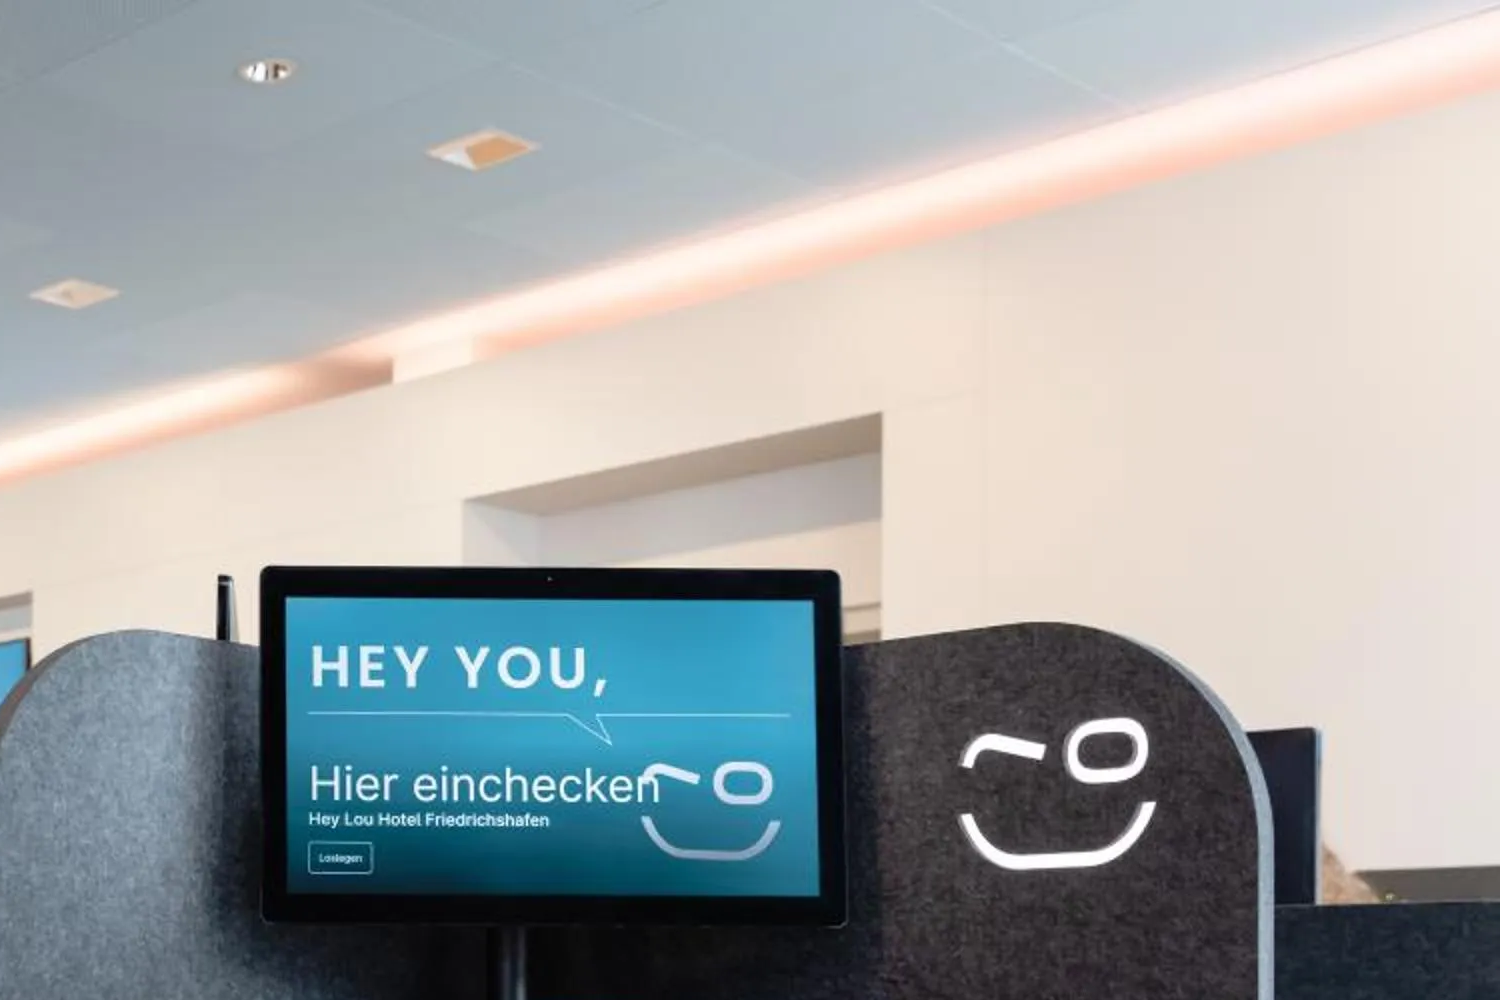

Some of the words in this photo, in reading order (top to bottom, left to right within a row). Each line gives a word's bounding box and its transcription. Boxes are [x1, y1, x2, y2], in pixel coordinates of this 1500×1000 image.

[312, 645, 429, 688] HEY
[454, 646, 607, 697] YOU,
[310, 764, 399, 802] Hier
[413, 765, 660, 803] einchecken
[308, 812, 339, 829] Hey
[344, 812, 374, 827] Lou
[378, 812, 422, 827] Hotel
[425, 812, 550, 828] Friedrichshafen
